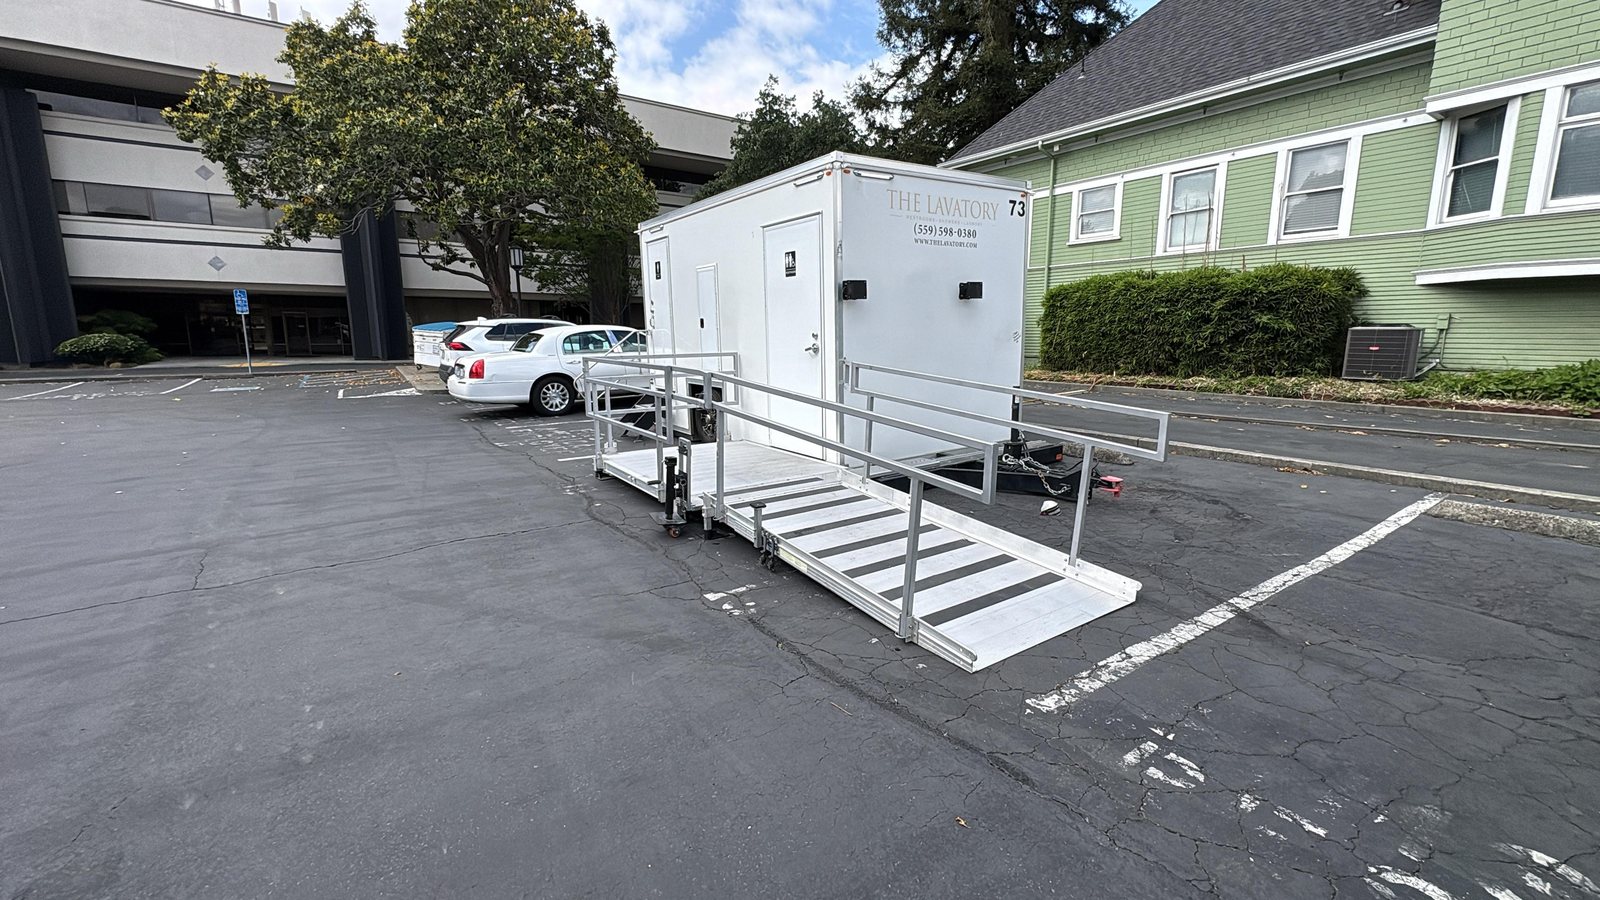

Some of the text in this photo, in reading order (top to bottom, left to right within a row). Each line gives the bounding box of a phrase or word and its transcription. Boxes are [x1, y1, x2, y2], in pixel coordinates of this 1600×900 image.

[886, 188, 921, 213] THE
[927, 194, 1000, 221] LAVATORY
[1008, 199, 1026, 217] 73
